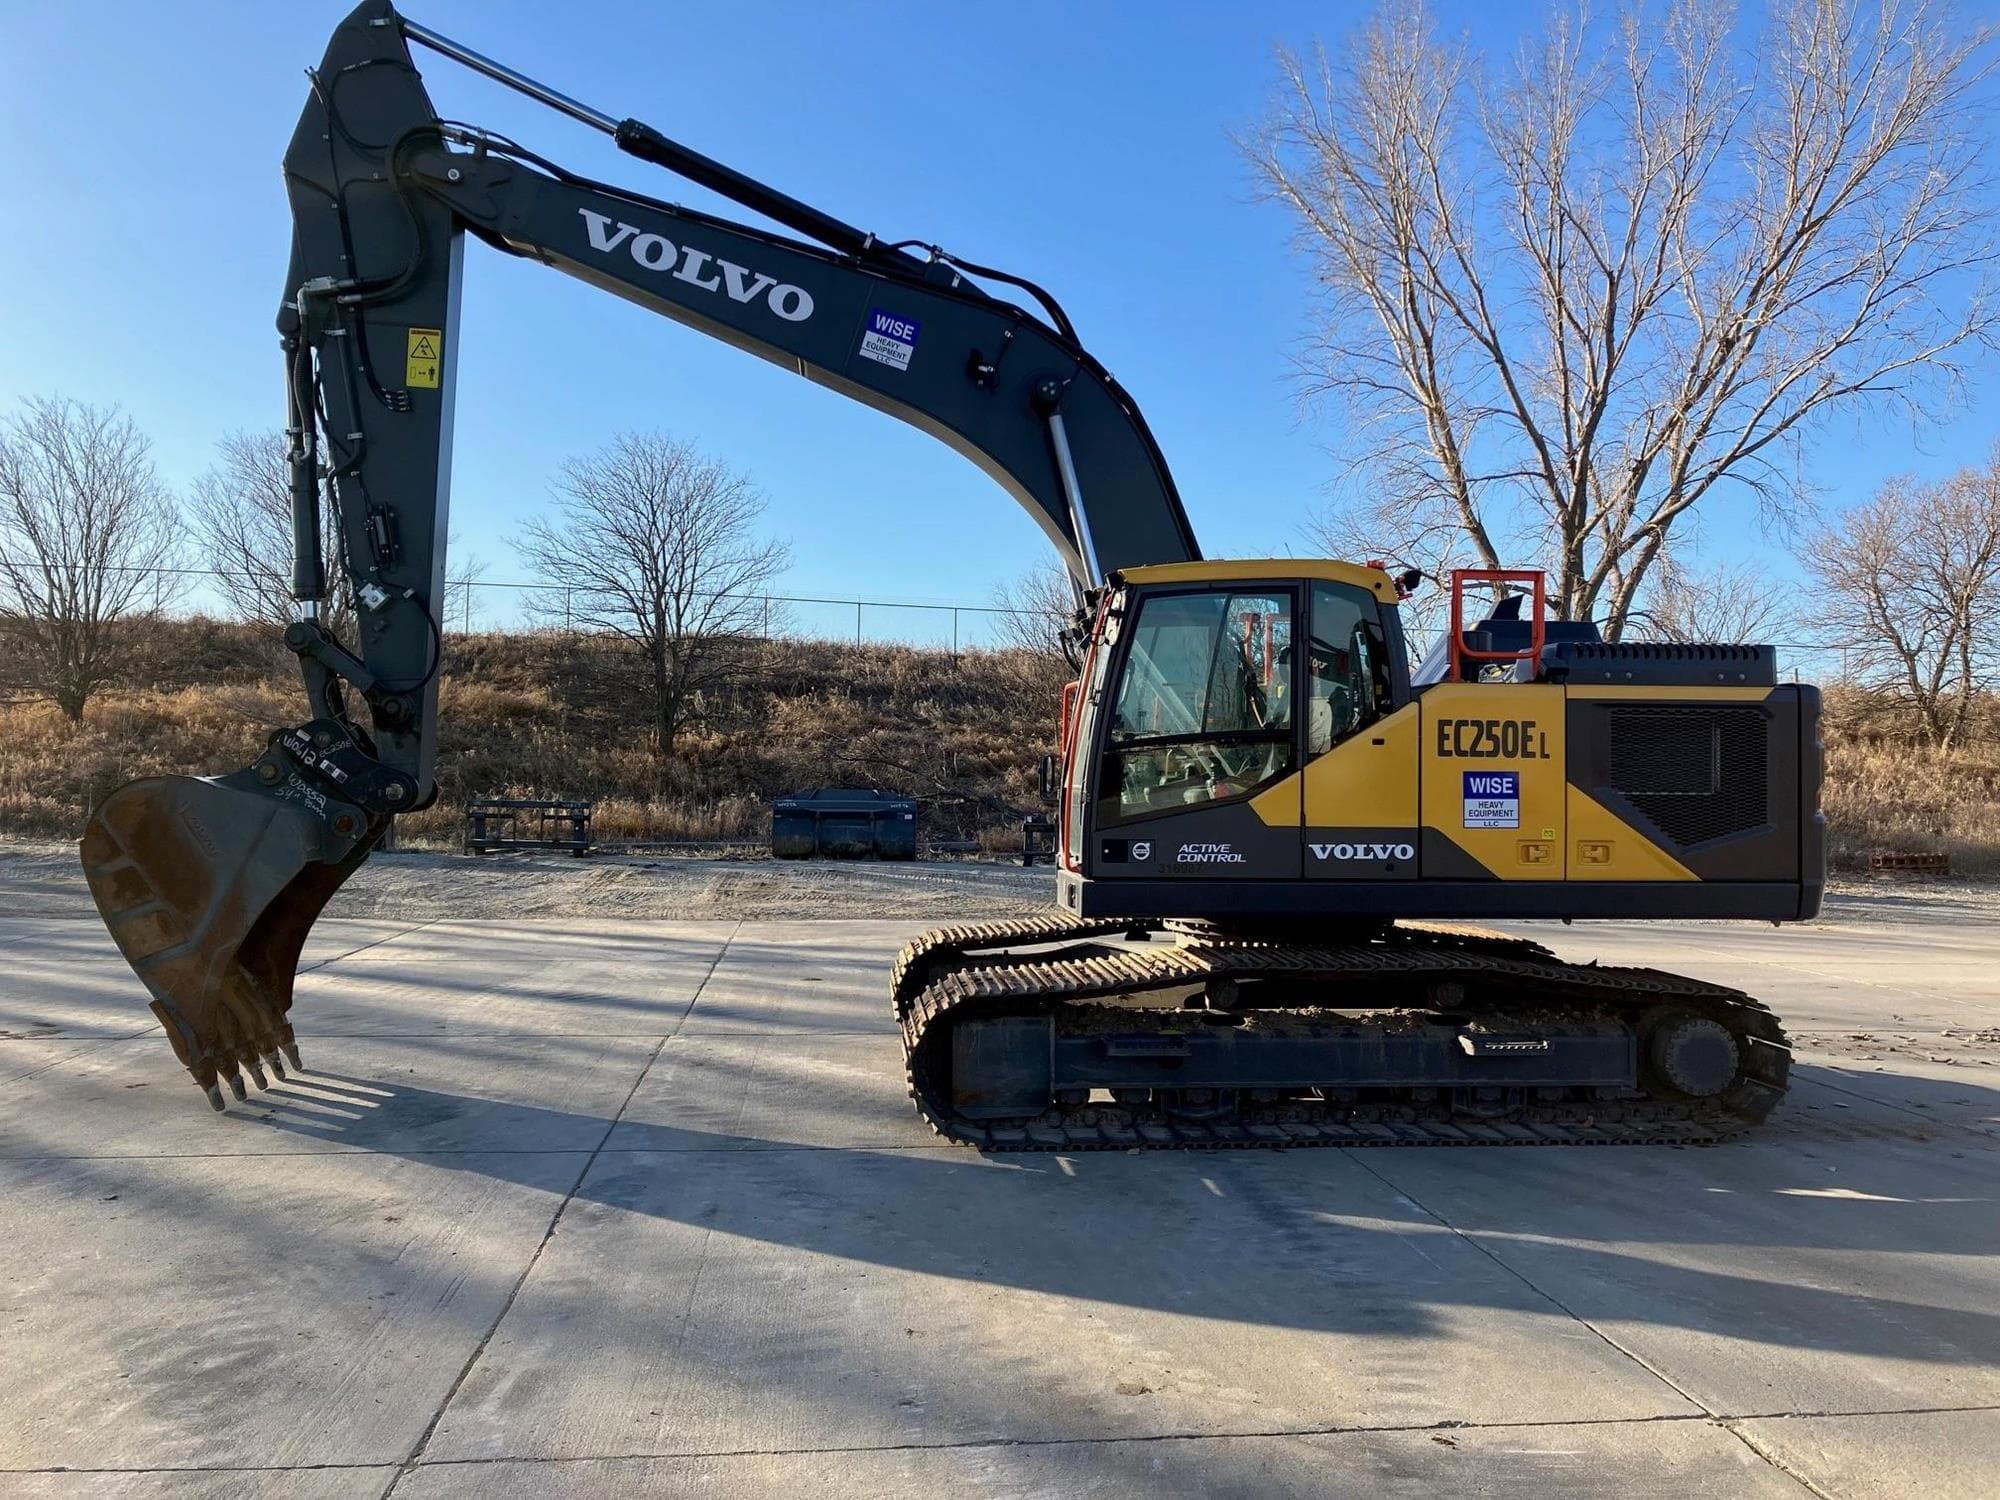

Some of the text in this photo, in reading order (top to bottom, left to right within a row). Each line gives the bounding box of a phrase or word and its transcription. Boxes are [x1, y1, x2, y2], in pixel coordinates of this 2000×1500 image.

[578, 207, 814, 322] VOLVO
[876, 314, 915, 341] WISE
[876, 337, 901, 350] HEAVY
[865, 341, 906, 361] EQUIPMENT
[876, 354, 891, 364] LLC
[1469, 777, 1514, 794] WISE
[1478, 801, 1504, 809] HEAVY
[1468, 809, 1514, 817] EQUIPMENT
[1179, 844, 1231, 853] ACTIVE
[1308, 844, 1414, 860] VOLVO
[1177, 853, 1247, 863] CONTROL
